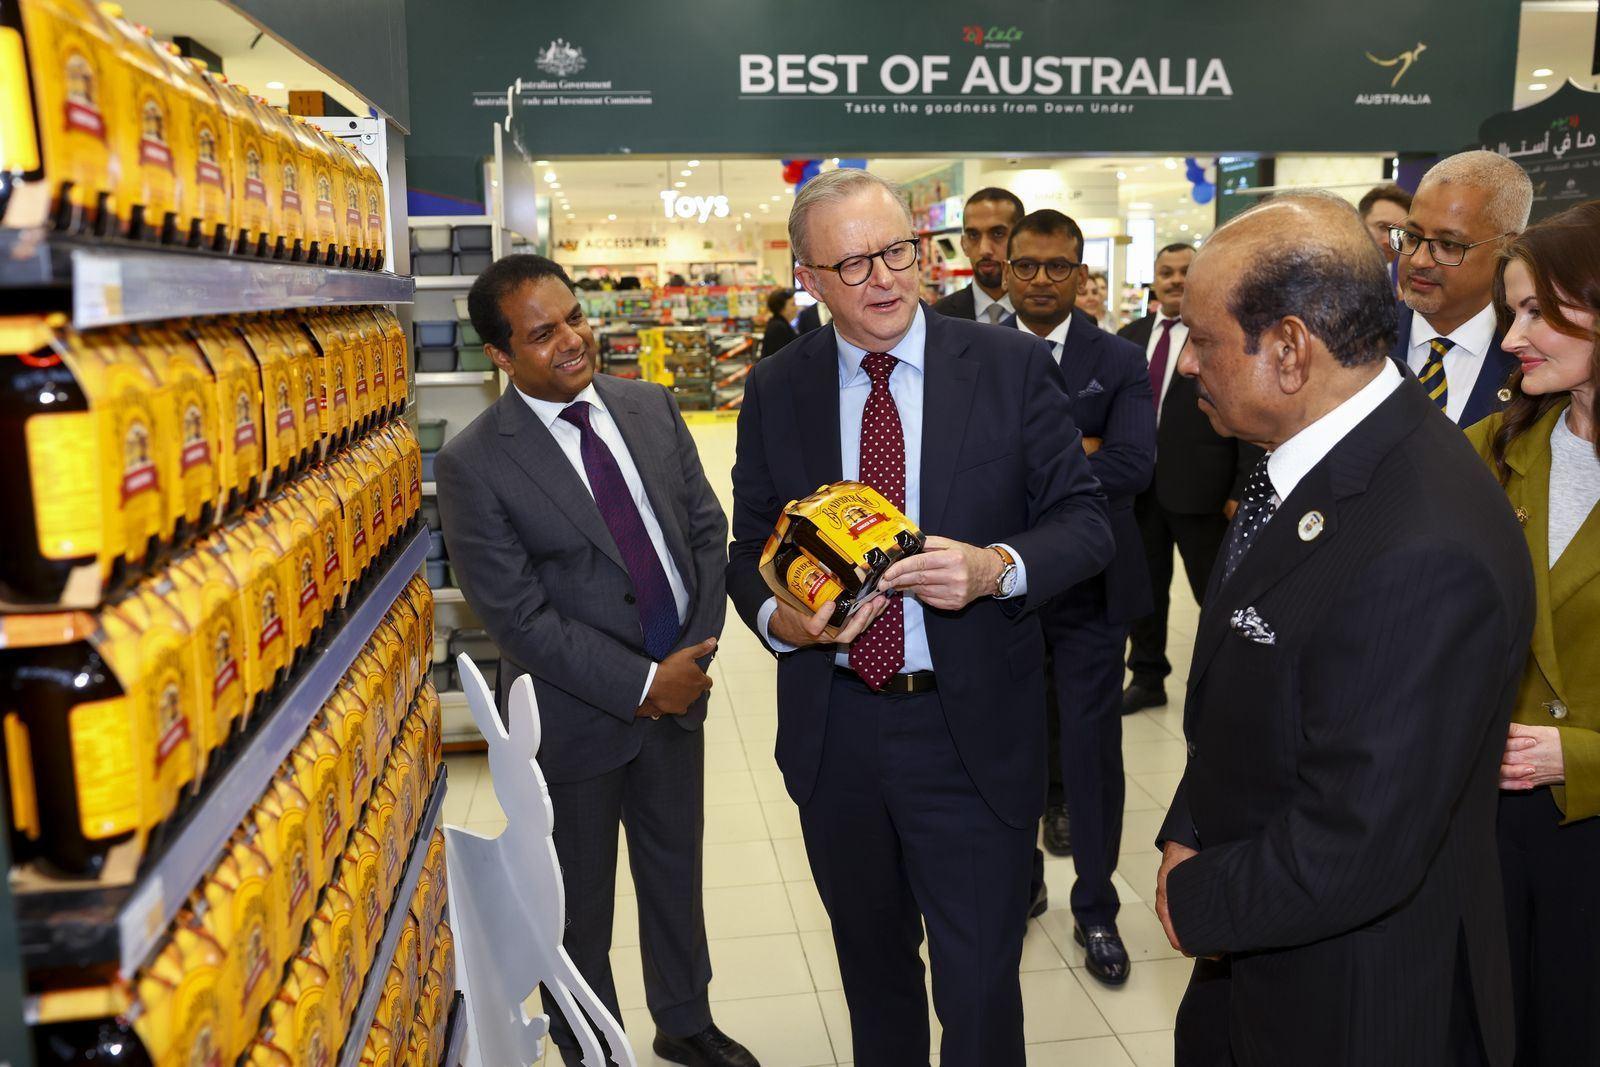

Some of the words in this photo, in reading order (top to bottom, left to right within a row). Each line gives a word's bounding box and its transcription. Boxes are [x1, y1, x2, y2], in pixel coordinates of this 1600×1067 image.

[740, 54, 868, 93] BEST
[880, 55, 950, 94] OF
[961, 56, 1233, 95] AUSTRALIA
[521, 79, 558, 90] ustralian
[559, 79, 612, 91] Government
[473, 97, 509, 106] Australia
[522, 97, 541, 106] rade
[543, 97, 558, 105] and
[604, 96, 653, 105] Commission
[1355, 94, 1431, 105] AUSTRALIA
[845, 102, 886, 114] Taste
[893, 102, 918, 114] the
[925, 102, 997, 116] goodness
[1003, 102, 1037, 114] from
[1045, 102, 1084, 114] Down
[1091, 102, 1134, 114] Under
[1553, 132, 1571, 159] في
[1576, 130, 1596, 149] ما
[660, 189, 730, 223] Toys
